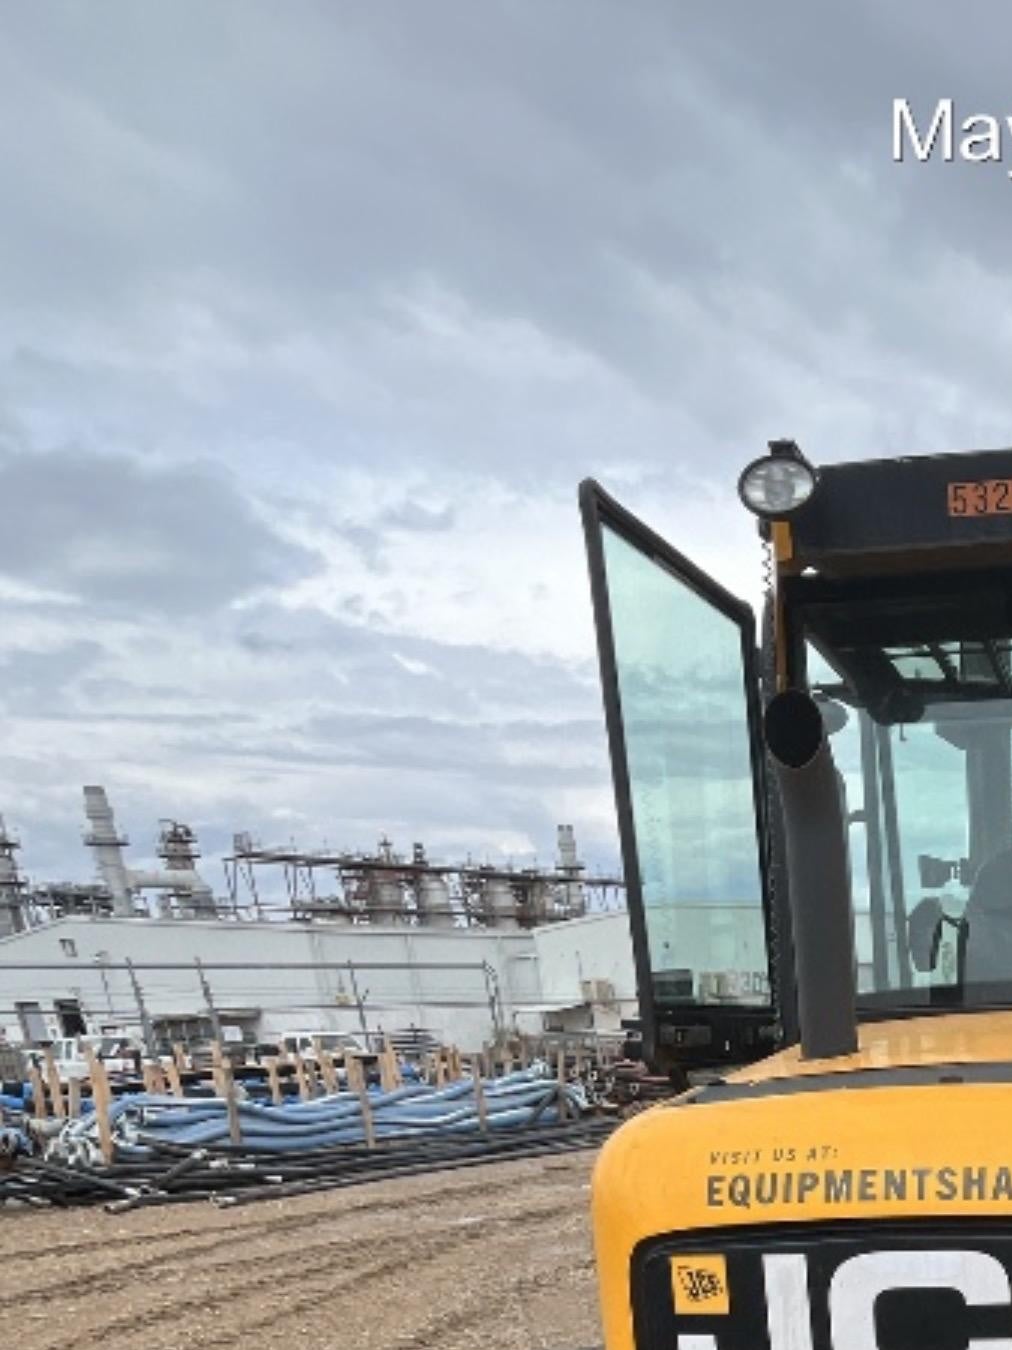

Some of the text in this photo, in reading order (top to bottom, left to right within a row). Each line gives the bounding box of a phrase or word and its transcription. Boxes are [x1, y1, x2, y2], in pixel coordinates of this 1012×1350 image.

[710, 1146, 838, 1165] VISIT US AT:
